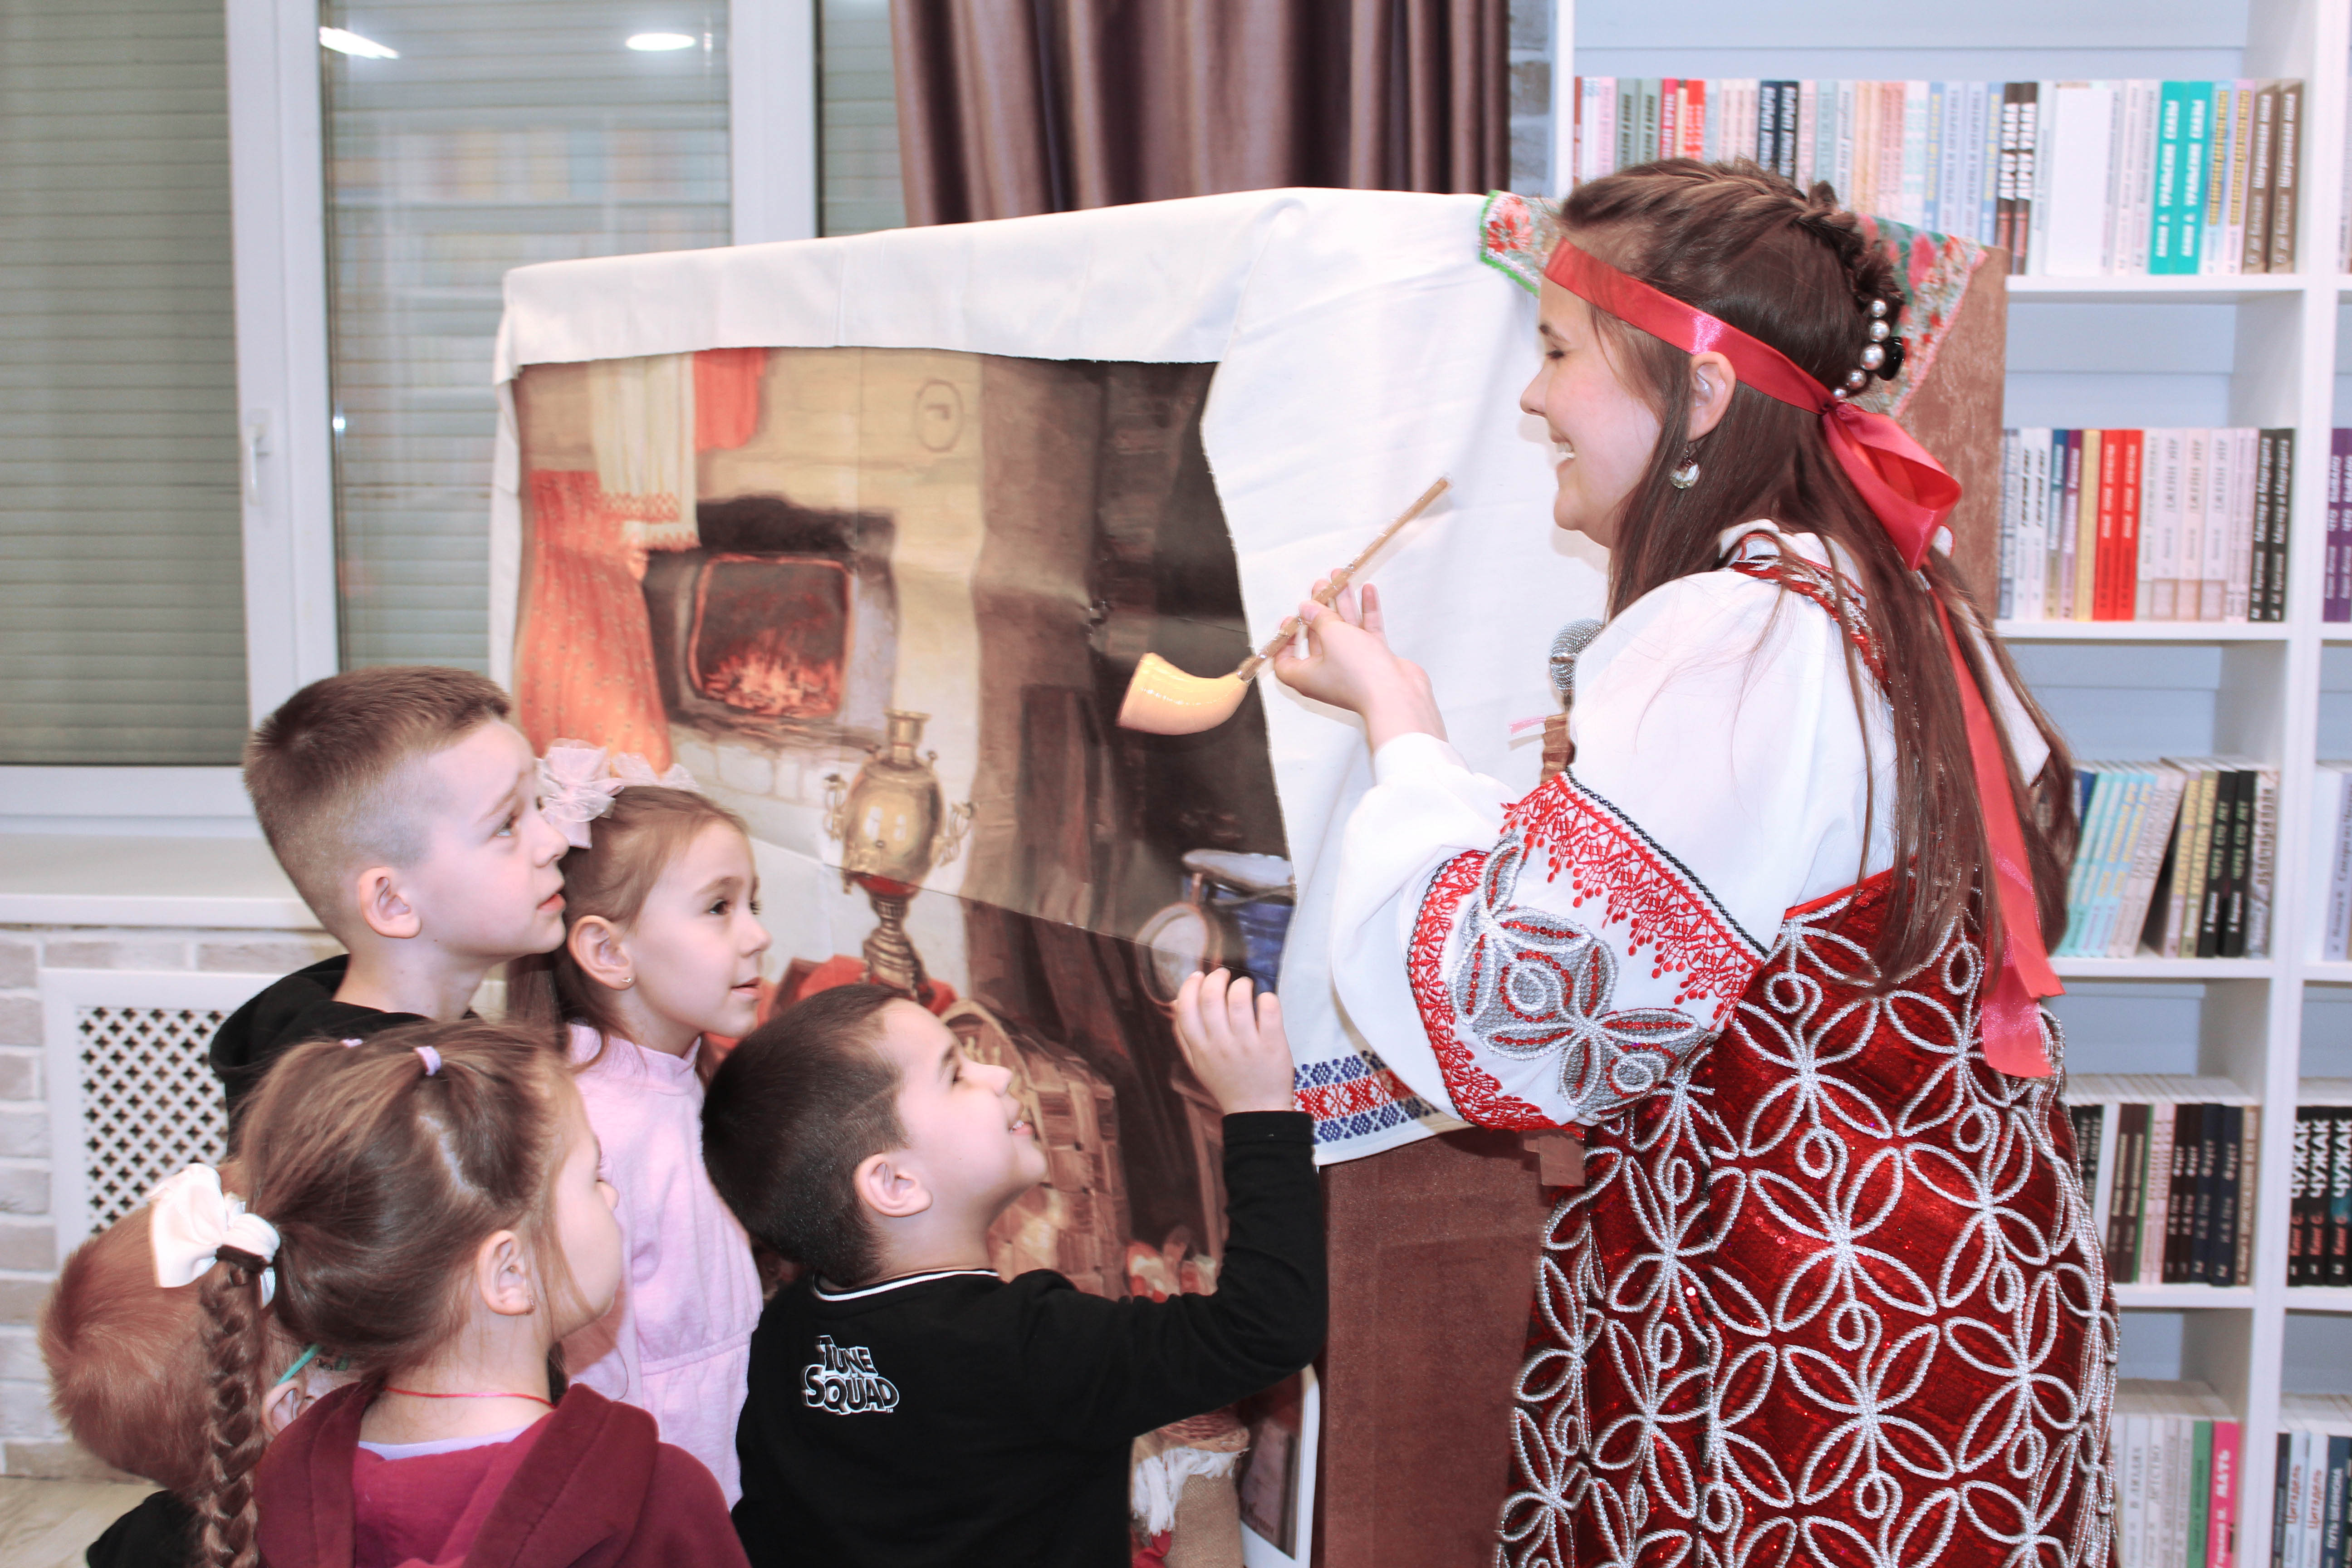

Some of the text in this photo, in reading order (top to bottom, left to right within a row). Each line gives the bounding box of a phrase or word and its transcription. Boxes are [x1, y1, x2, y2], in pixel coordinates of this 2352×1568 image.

[2291, 1121, 2311, 1198] ЧУЖАК
[2310, 1120, 2331, 1198] ЧУЖАК
[2331, 1120, 2352, 1198] ЧУЖАК
[815, 1335, 878, 1377] TUNE
[800, 1364, 899, 1415] SQUAD
[2216, 1449, 2230, 1498] МАТЬ
[2285, 1465, 2301, 1524] Цитадель
[2306, 1469, 2323, 1530] Цитадель
